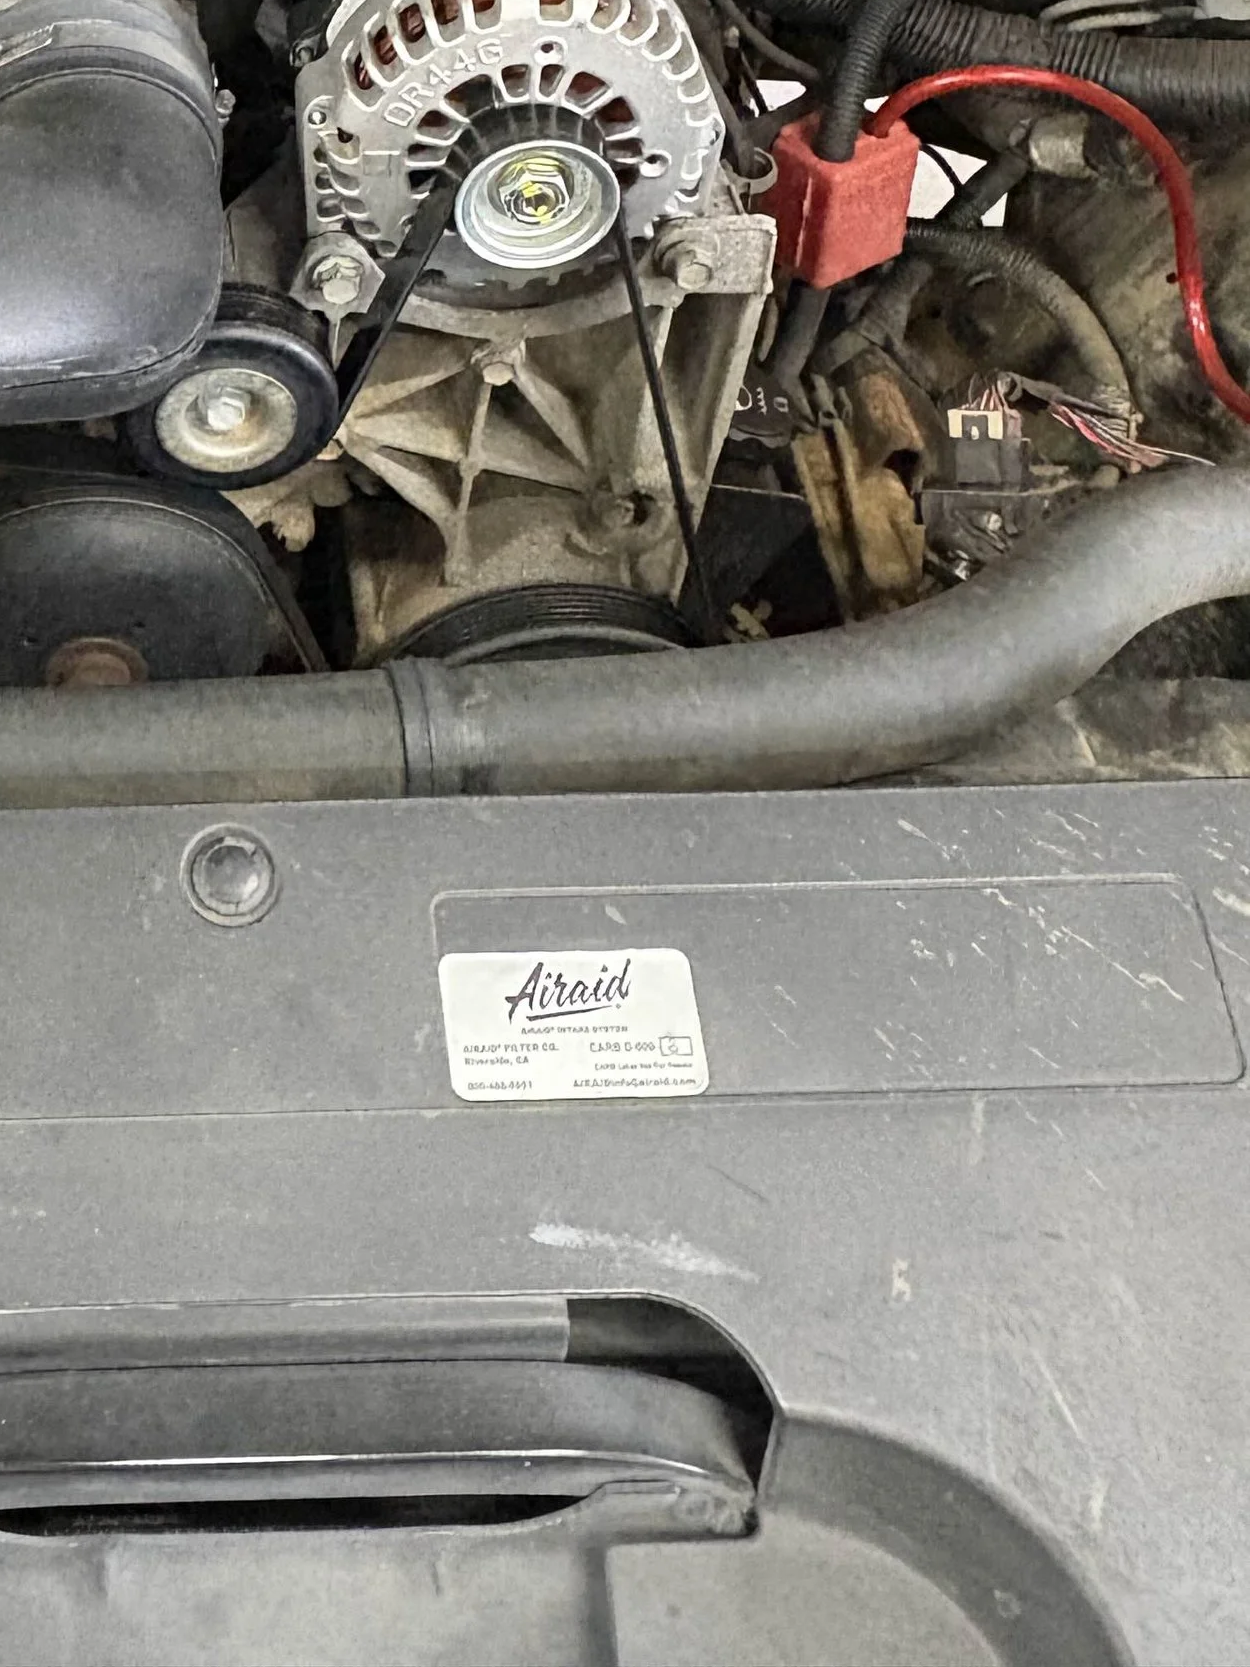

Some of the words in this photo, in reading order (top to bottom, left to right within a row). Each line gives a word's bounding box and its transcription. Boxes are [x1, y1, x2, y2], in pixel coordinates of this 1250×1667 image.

[383, 37, 504, 128] DR44G
[504, 957, 633, 1025] Airaid
[515, 1055, 529, 1064] CA
